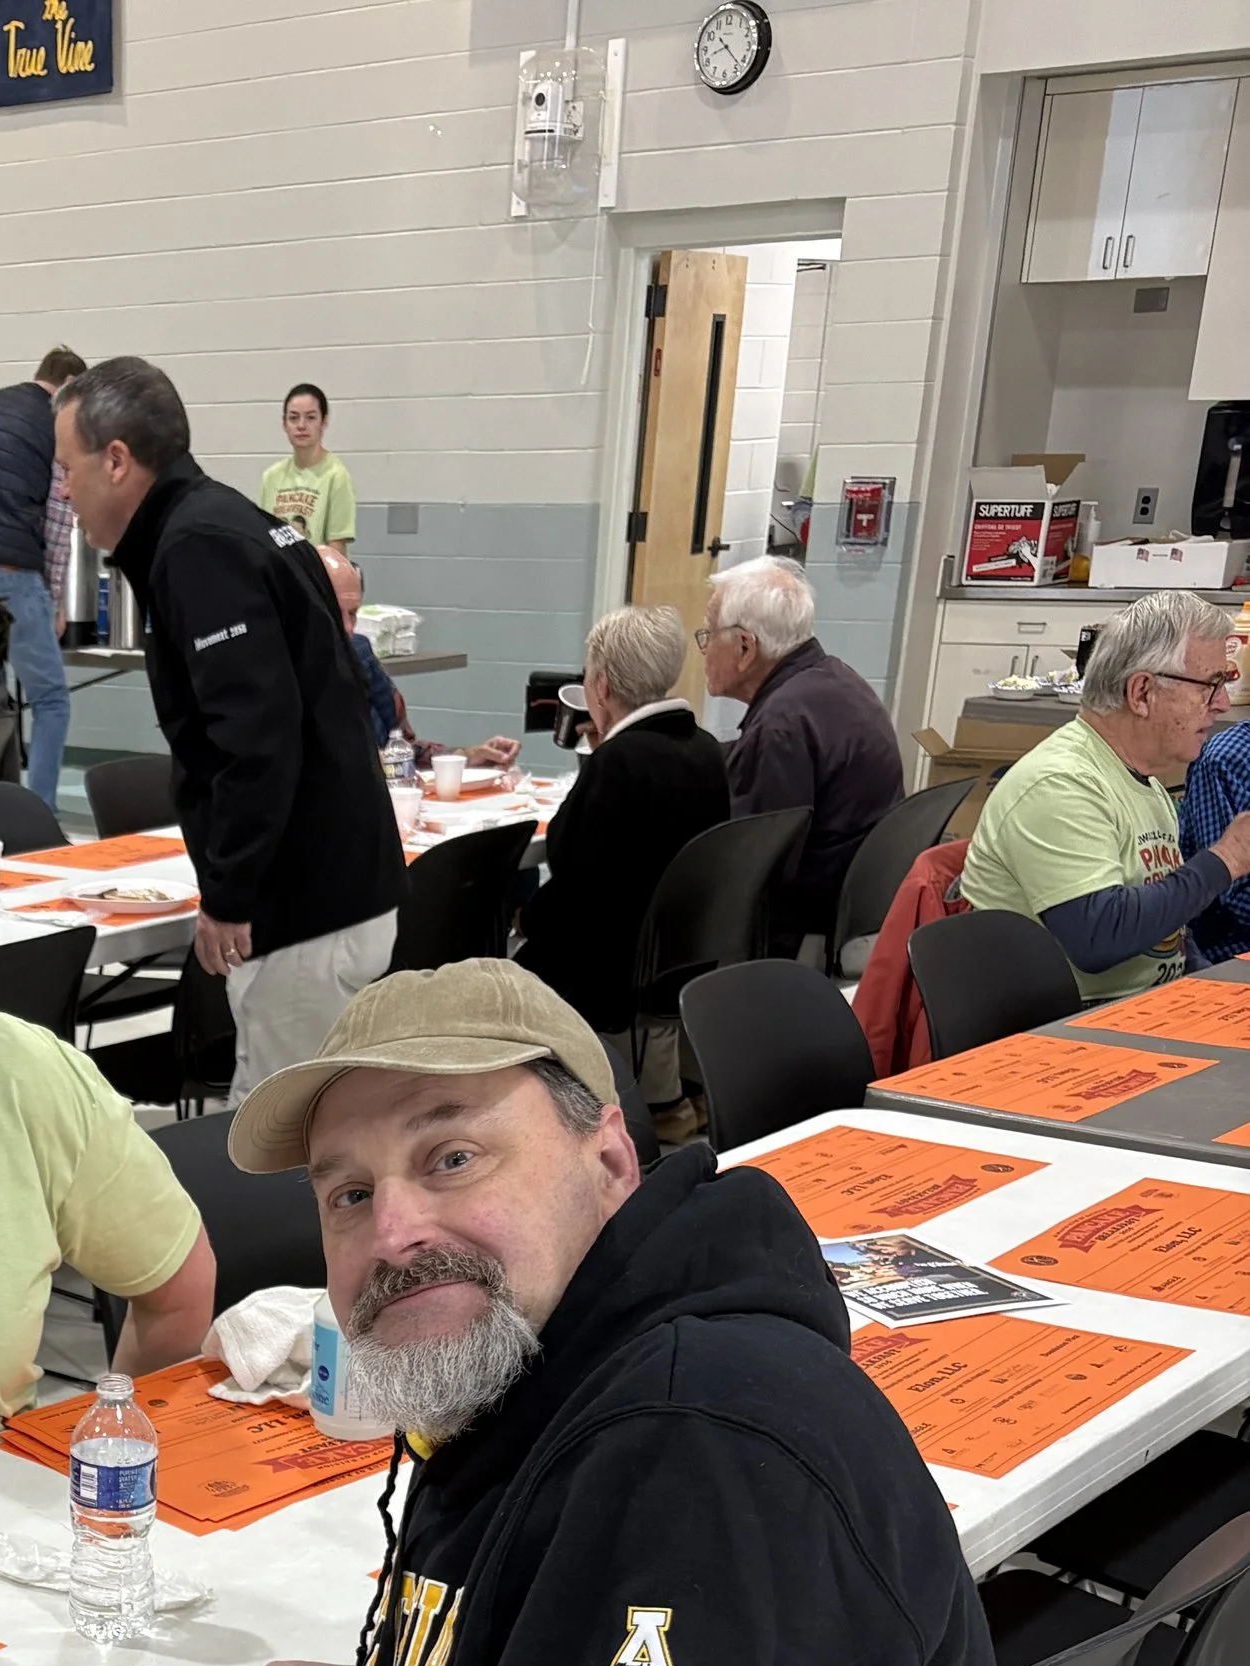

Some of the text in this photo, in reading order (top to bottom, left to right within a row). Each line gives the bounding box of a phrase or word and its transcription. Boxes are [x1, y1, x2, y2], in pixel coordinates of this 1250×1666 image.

[42, 0, 68, 20] the
[716, 20, 721, 30] 11
[725, 15, 732, 25] 12
[739, 18, 742, 28] 1
[707, 31, 715, 41] 10
[745, 28, 749, 37] 2
[3, 18, 94, 78] True Vine
[703, 46, 708, 55] 9
[746, 41, 750, 51] 3
[705, 58, 710, 66] 8
[741, 55, 746, 63] 4
[722, 69, 727, 77] 6
[733, 64, 738, 73] 5
[979, 505, 1033, 517] SUPERTUFF
[194, 628, 228, 652] Movement
[1152, 1239, 1185, 1253] Elon,
[1179, 1226, 1202, 1241] LLC
[907, 1375, 950, 1392] Elon,
[936, 1362, 967, 1378] LLC
[247, 1416, 287, 1433] LLC
